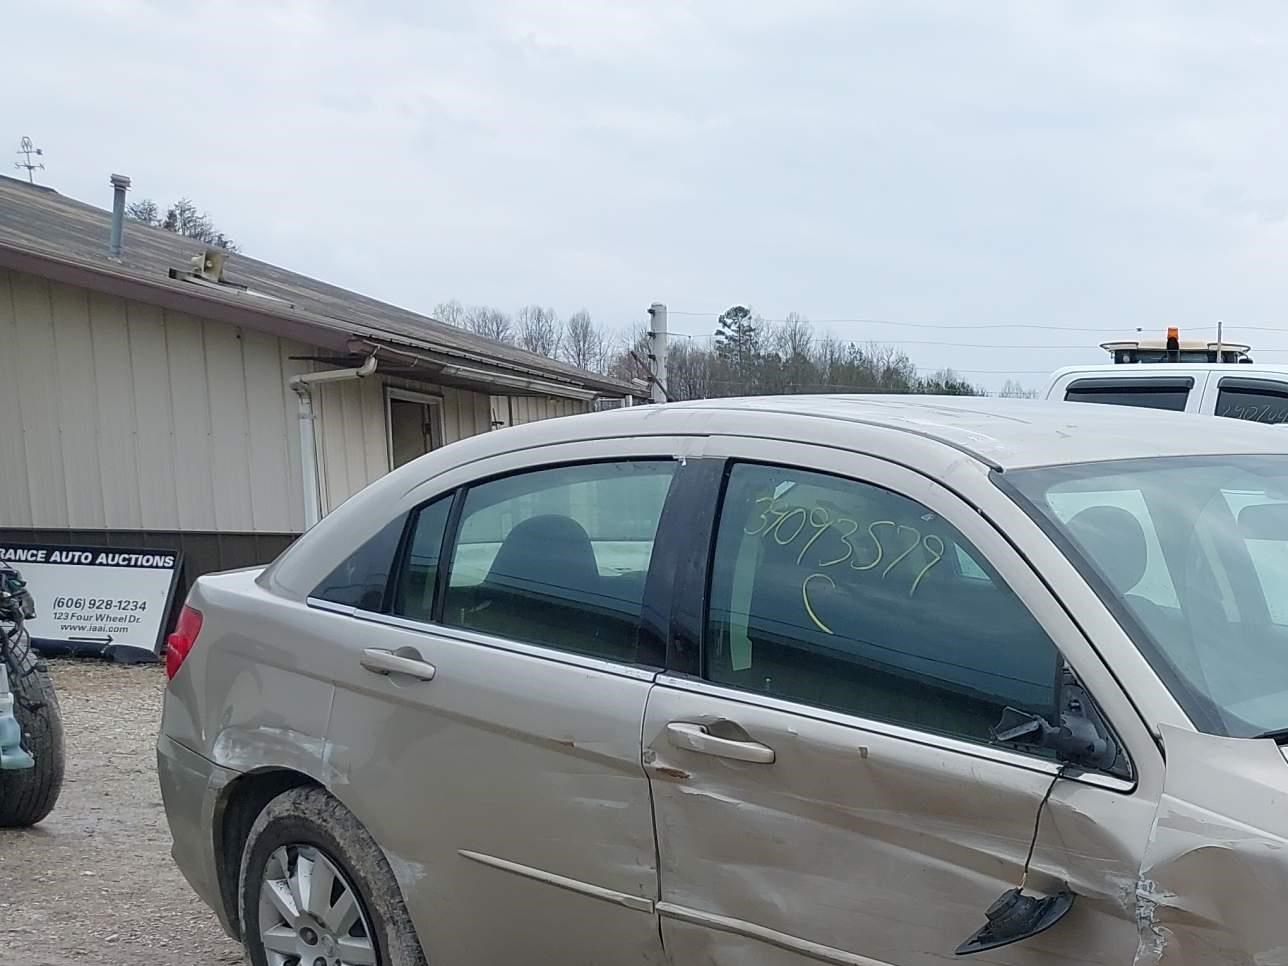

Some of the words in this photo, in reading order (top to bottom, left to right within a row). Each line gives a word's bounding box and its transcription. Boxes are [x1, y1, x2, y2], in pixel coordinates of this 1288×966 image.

[744, 496, 944, 597] 39093579
[50, 550, 93, 564] AUTO
[96, 552, 175, 567] AUCTIONS
[53, 596, 86, 611] (606)
[88, 598, 147, 612] 928-1234
[53, 612, 69, 621] 123
[70, 612, 94, 622] Four
[95, 613, 128, 623] Wheel
[60, 623, 129, 633] www.iaai.com
